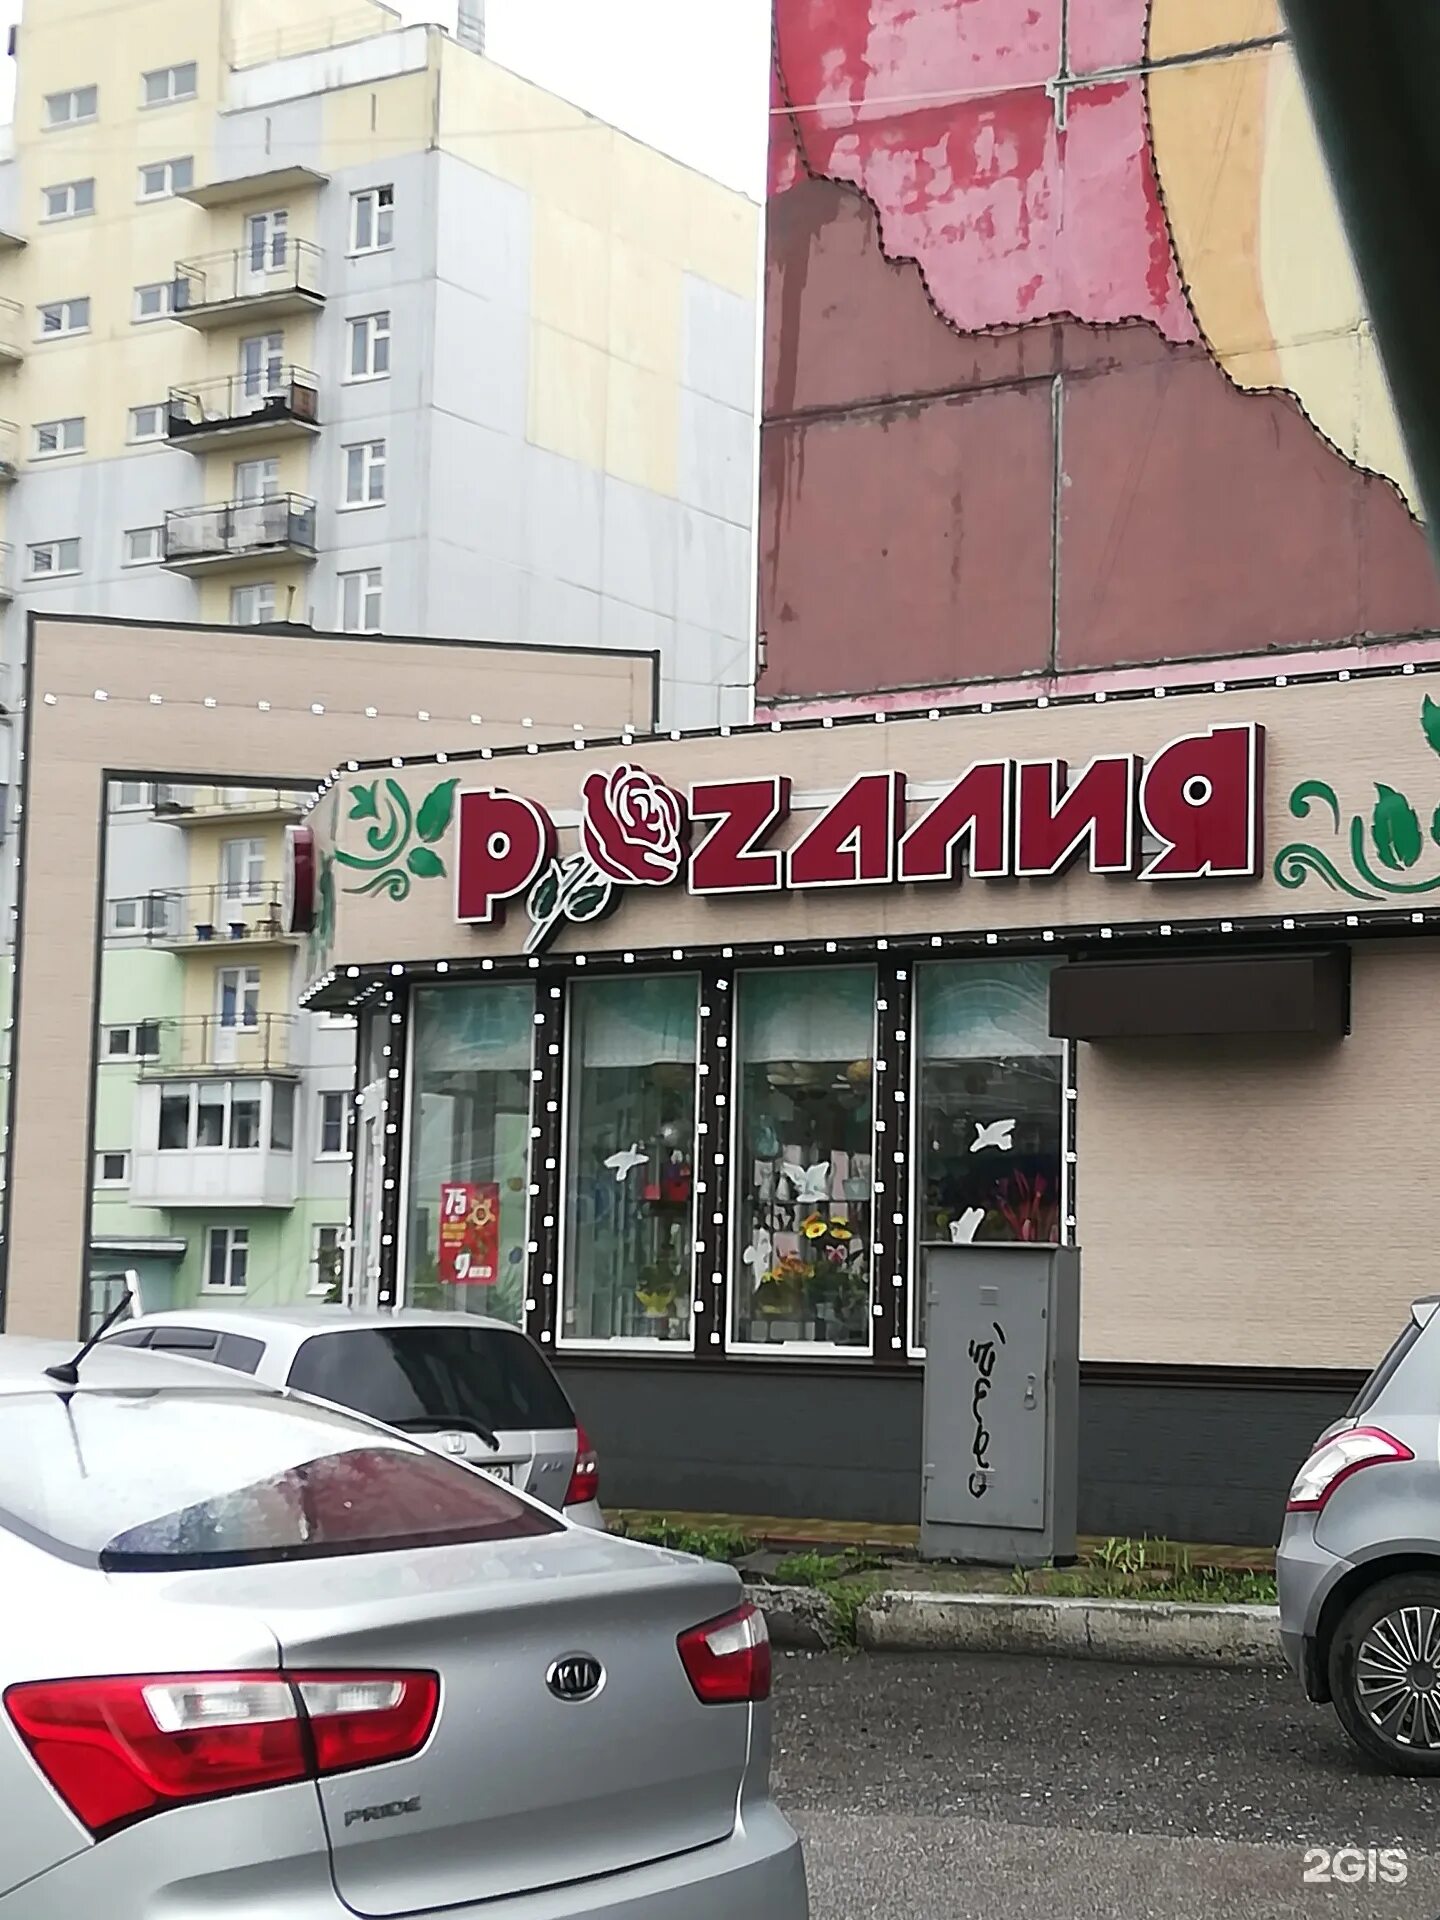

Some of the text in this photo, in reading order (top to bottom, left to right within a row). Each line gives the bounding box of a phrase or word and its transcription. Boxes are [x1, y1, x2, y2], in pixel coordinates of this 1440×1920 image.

[444, 1188, 467, 1216] 75
[455, 1253, 471, 1279] 9
[557, 1663, 595, 1689] KIA
[344, 1795, 423, 1827] PRIDE
